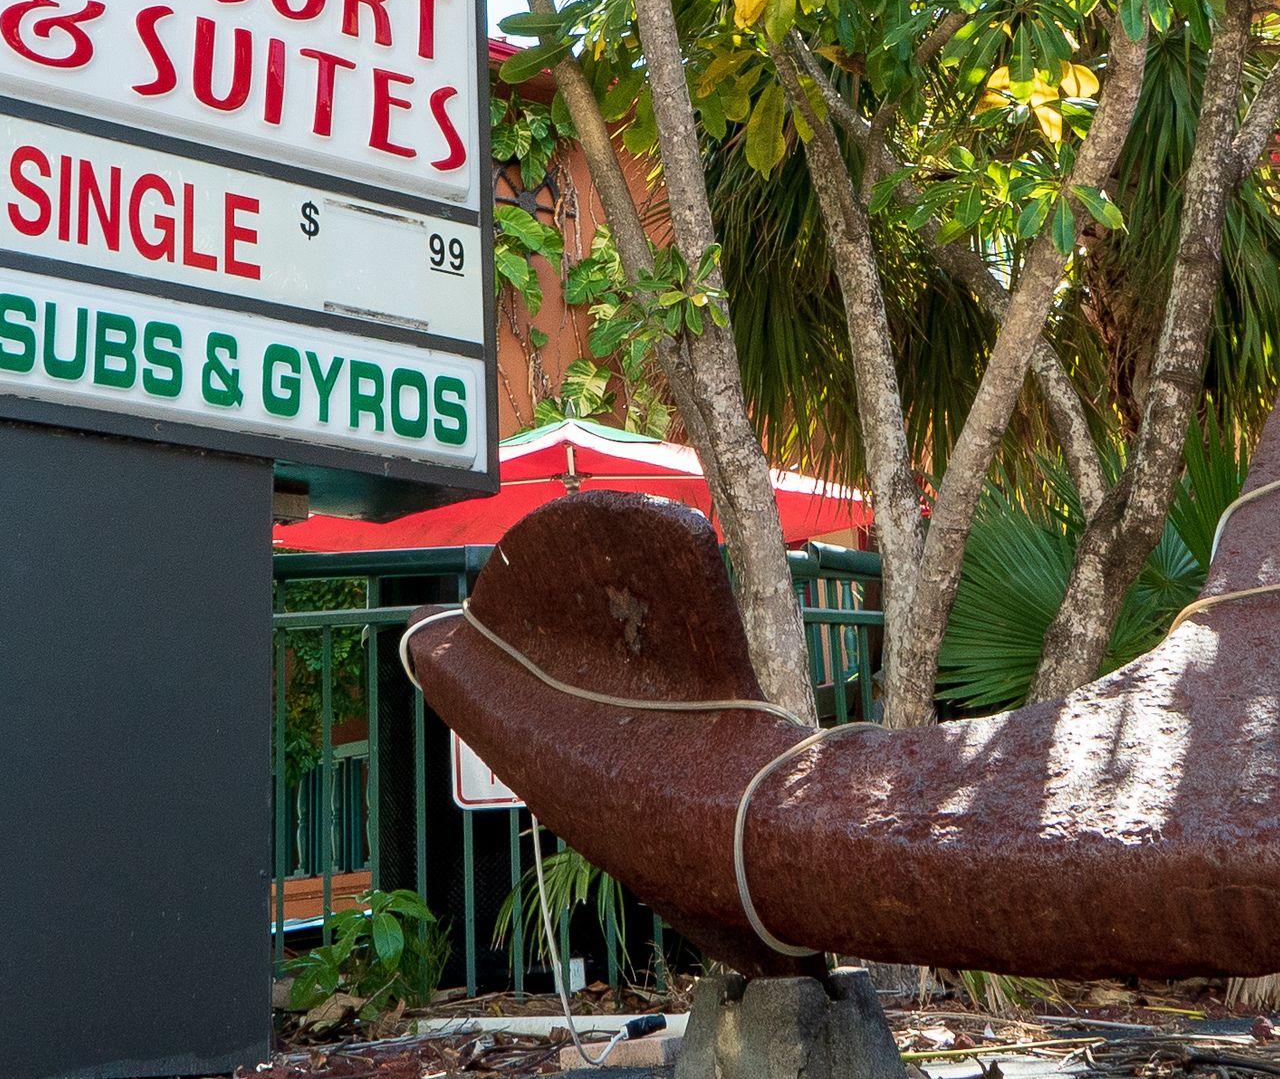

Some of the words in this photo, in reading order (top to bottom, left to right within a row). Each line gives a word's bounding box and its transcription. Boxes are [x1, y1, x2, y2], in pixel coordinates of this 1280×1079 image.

[131, 5, 468, 172] SUITES
[7, 145, 262, 281] SINGLE
[299, 201, 320, 241] $
[428, 233, 466, 274] 99
[200, 330, 244, 409] &
[261, 342, 469, 447] GYROS
